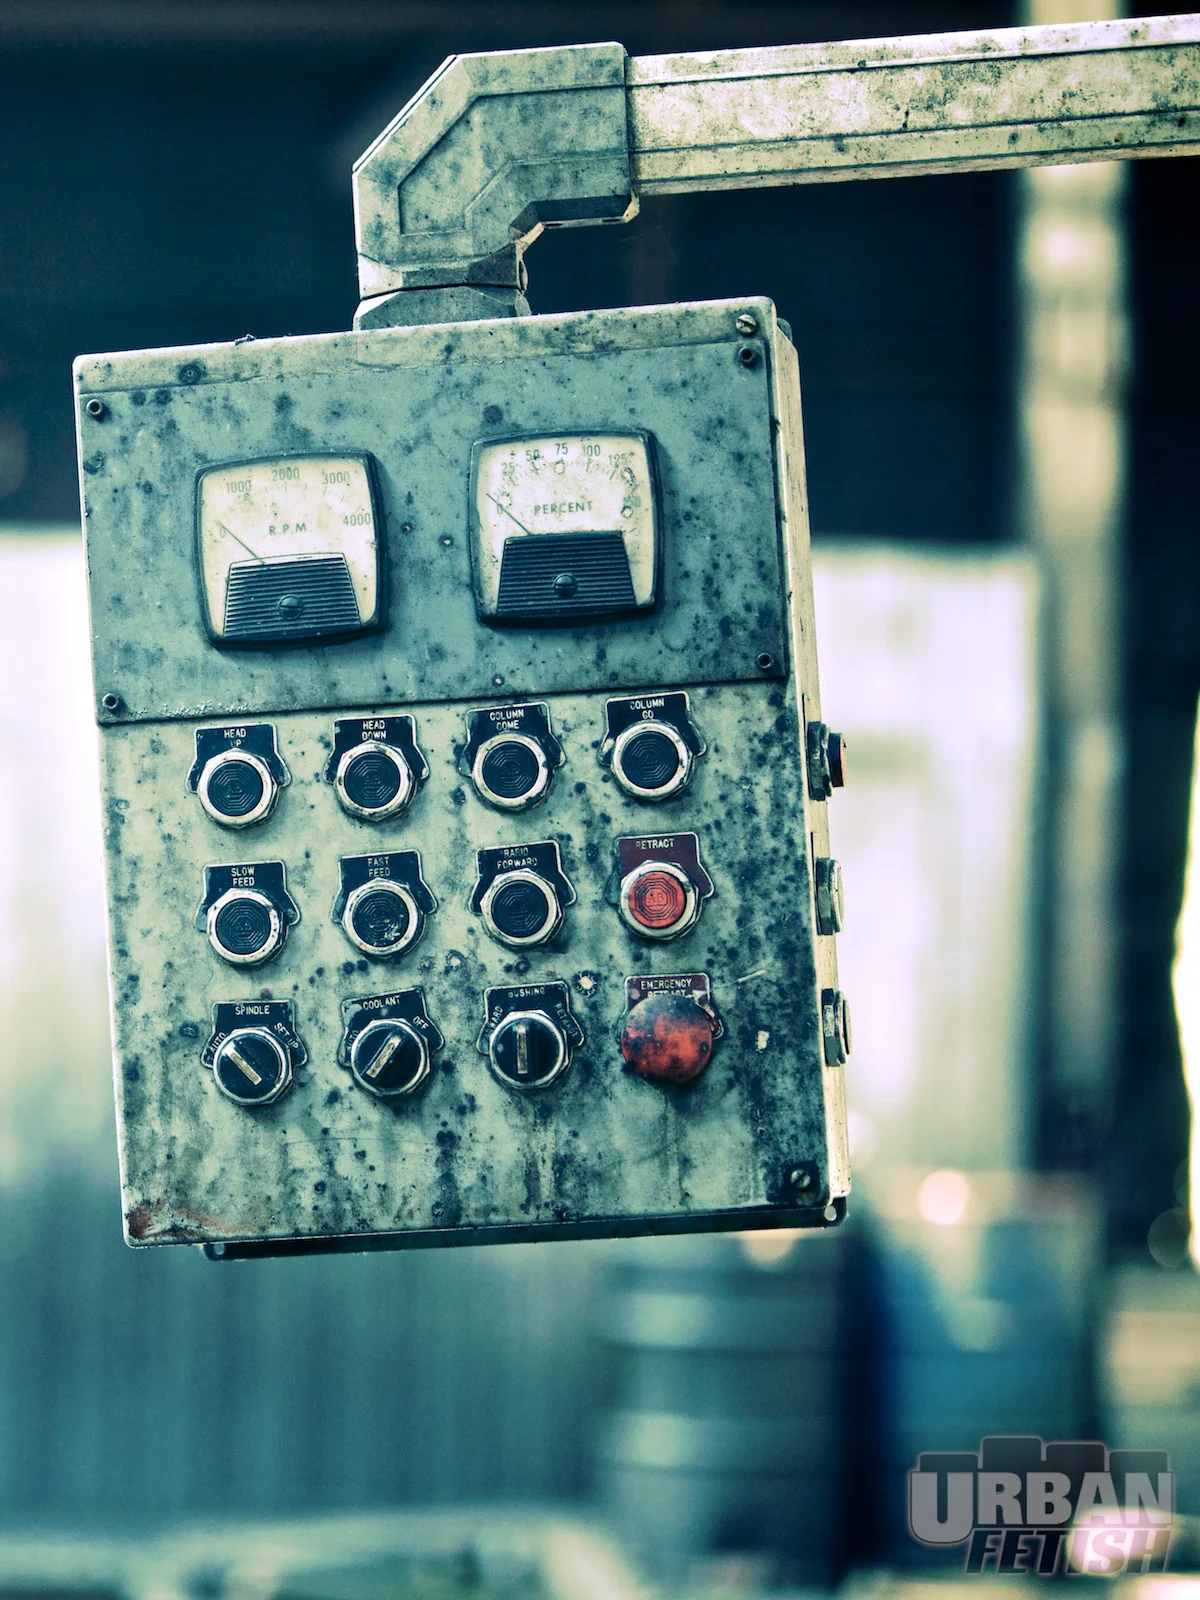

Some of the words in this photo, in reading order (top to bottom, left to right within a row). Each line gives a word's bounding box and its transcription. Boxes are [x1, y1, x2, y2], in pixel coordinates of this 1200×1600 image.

[526, 448, 540, 462] 50
[555, 442, 568, 455] 75
[583, 444, 601, 457] 100
[608, 454, 627, 467] 125
[272, 467, 300, 482] 2000
[502, 462, 516, 476] 25
[323, 471, 350, 486] 3000
[226, 480, 252, 494] 1000
[534, 501, 592, 515] PERCENT
[343, 512, 371, 527] 4000
[629, 698, 665, 711] COLUMN
[489, 709, 525, 721] COLUMN
[642, 710, 654, 720] GO
[362, 720, 386, 731] HEAD
[496, 719, 520, 731] COME
[223, 728, 247, 739] HEAD
[361, 730, 387, 741] DOWN
[635, 838, 675, 850] RETRACT
[503, 846, 529, 858] RAPID
[367, 856, 390, 867] FAST
[497, 857, 538, 870] FORWARD
[231, 866, 255, 877] SLOW
[368, 866, 391, 877] FEED
[232, 876, 256, 887] FEED
[640, 978, 692, 990] EMERGENCY
[362, 995, 401, 1011] COOLANT
[234, 1005, 271, 1016] SPINDLE
[412, 1015, 429, 1031] OFF
[210, 1031, 227, 1053] AUTO
[273, 1022, 291, 1037] SET
[286, 1038, 300, 1049] UP
